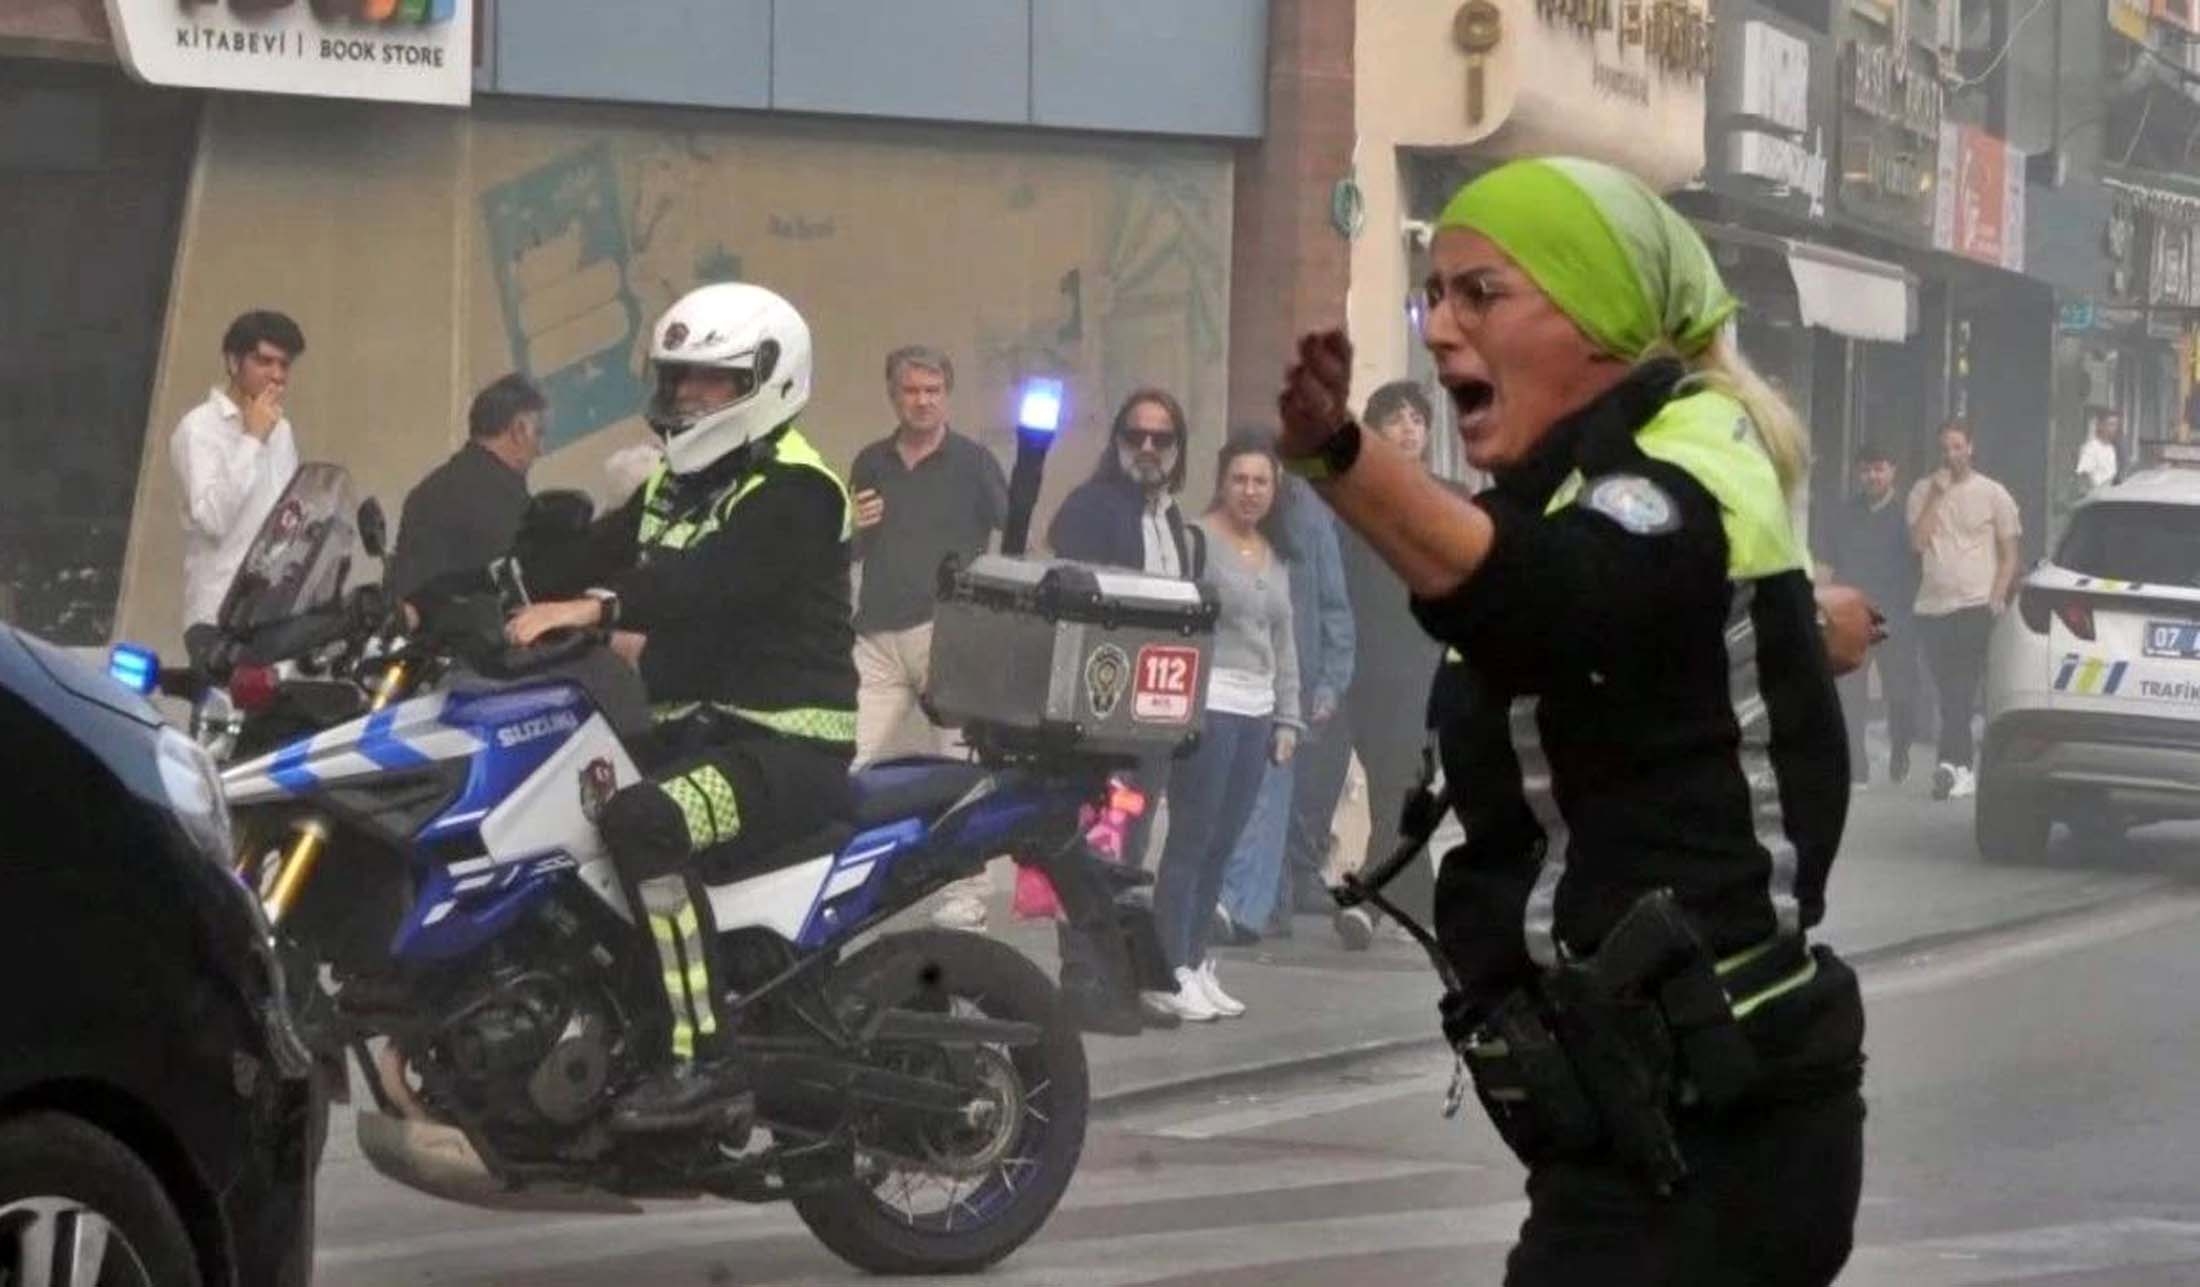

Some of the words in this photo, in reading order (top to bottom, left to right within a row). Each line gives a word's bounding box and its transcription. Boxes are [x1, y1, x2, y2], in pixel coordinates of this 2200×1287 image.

[176, 25, 286, 54] KİTABEVİ
[319, 39, 376, 61] BOOK
[382, 43, 444, 67] STORE
[2154, 627, 2181, 649] 07
[1146, 656, 1187, 691] 112
[497, 709, 578, 748] SUZUKI
